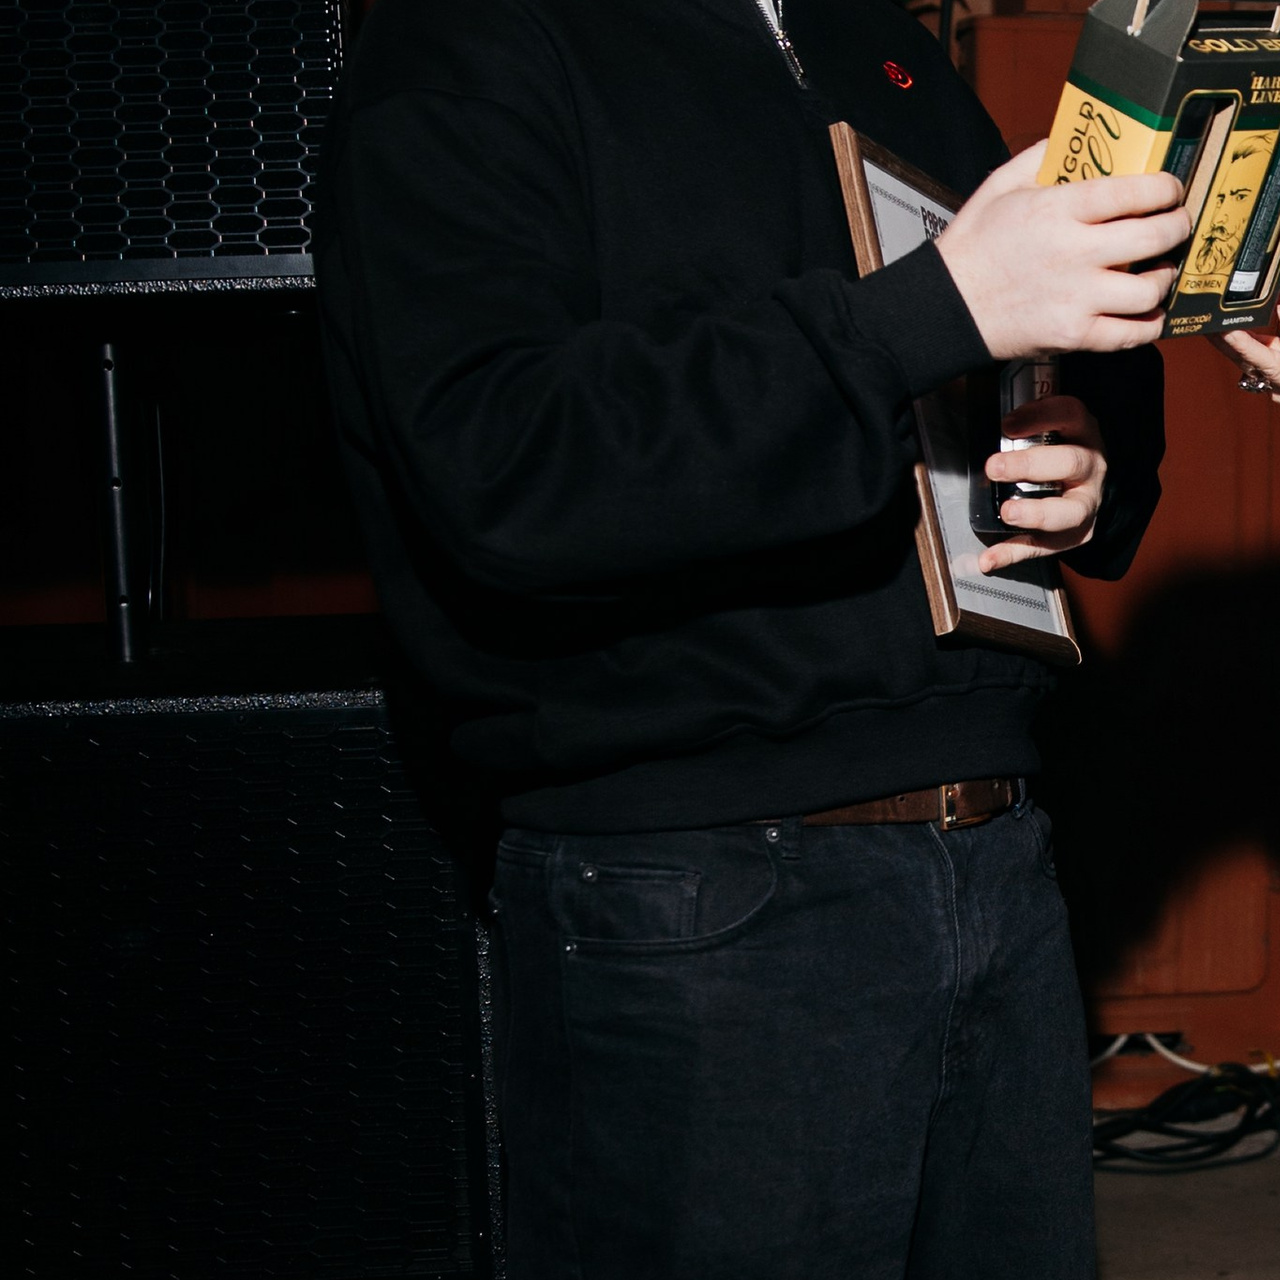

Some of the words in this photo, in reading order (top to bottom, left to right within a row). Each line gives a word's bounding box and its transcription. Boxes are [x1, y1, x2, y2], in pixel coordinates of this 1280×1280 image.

[1188, 38, 1259, 53] GOLD
[1063, 101, 1094, 174] GOLD
[1184, 280, 1203, 289] FOR
[1203, 280, 1222, 288] MEN
[1170, 313, 1212, 326] МУЖСКОЙ
[1172, 324, 1202, 334] НАБОР
